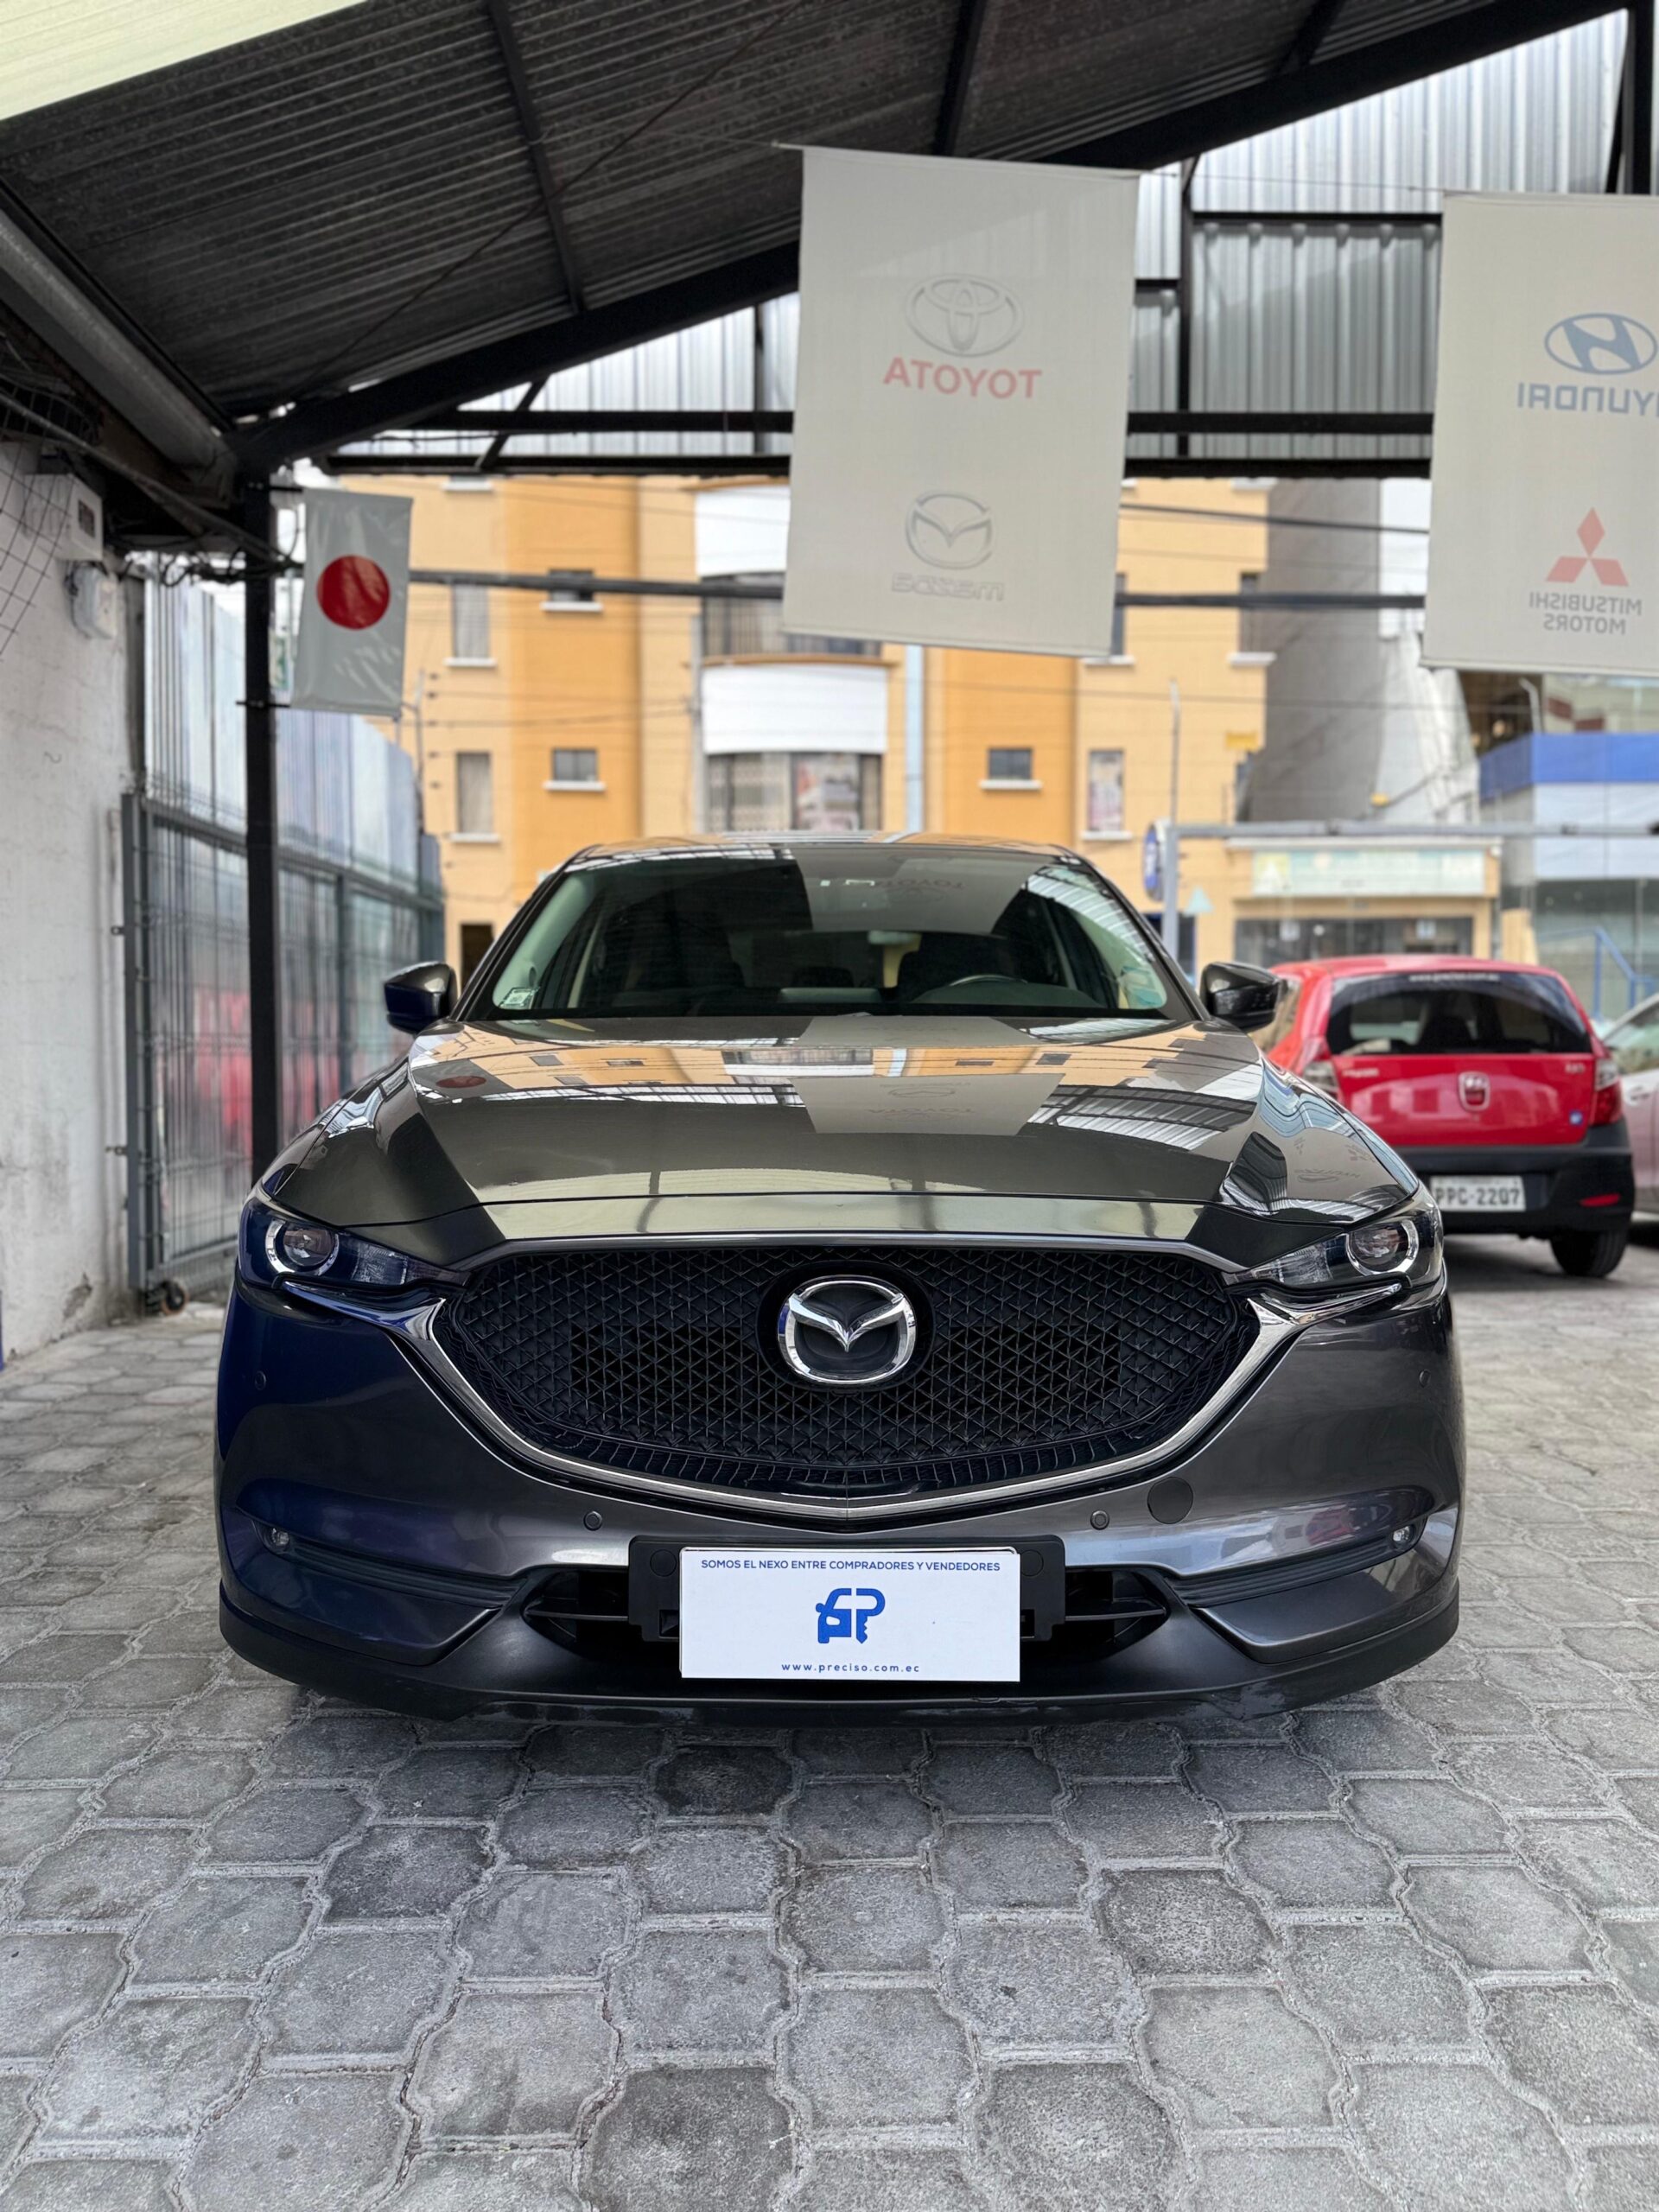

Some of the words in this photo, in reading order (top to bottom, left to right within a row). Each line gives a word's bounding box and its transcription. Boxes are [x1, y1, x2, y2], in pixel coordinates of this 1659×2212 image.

[701, 1559, 741, 1569] SOMOS
[743, 1560, 757, 1569] EL
[759, 1560, 789, 1569] NEXO
[791, 1560, 827, 1570] ENTRE
[829, 1560, 915, 1571] COMPRADORES
[917, 1561, 925, 1571] Y
[925, 1561, 1001, 1572] VENDEDORES
[781, 1662, 920, 1674] www.preciso.com.ec
